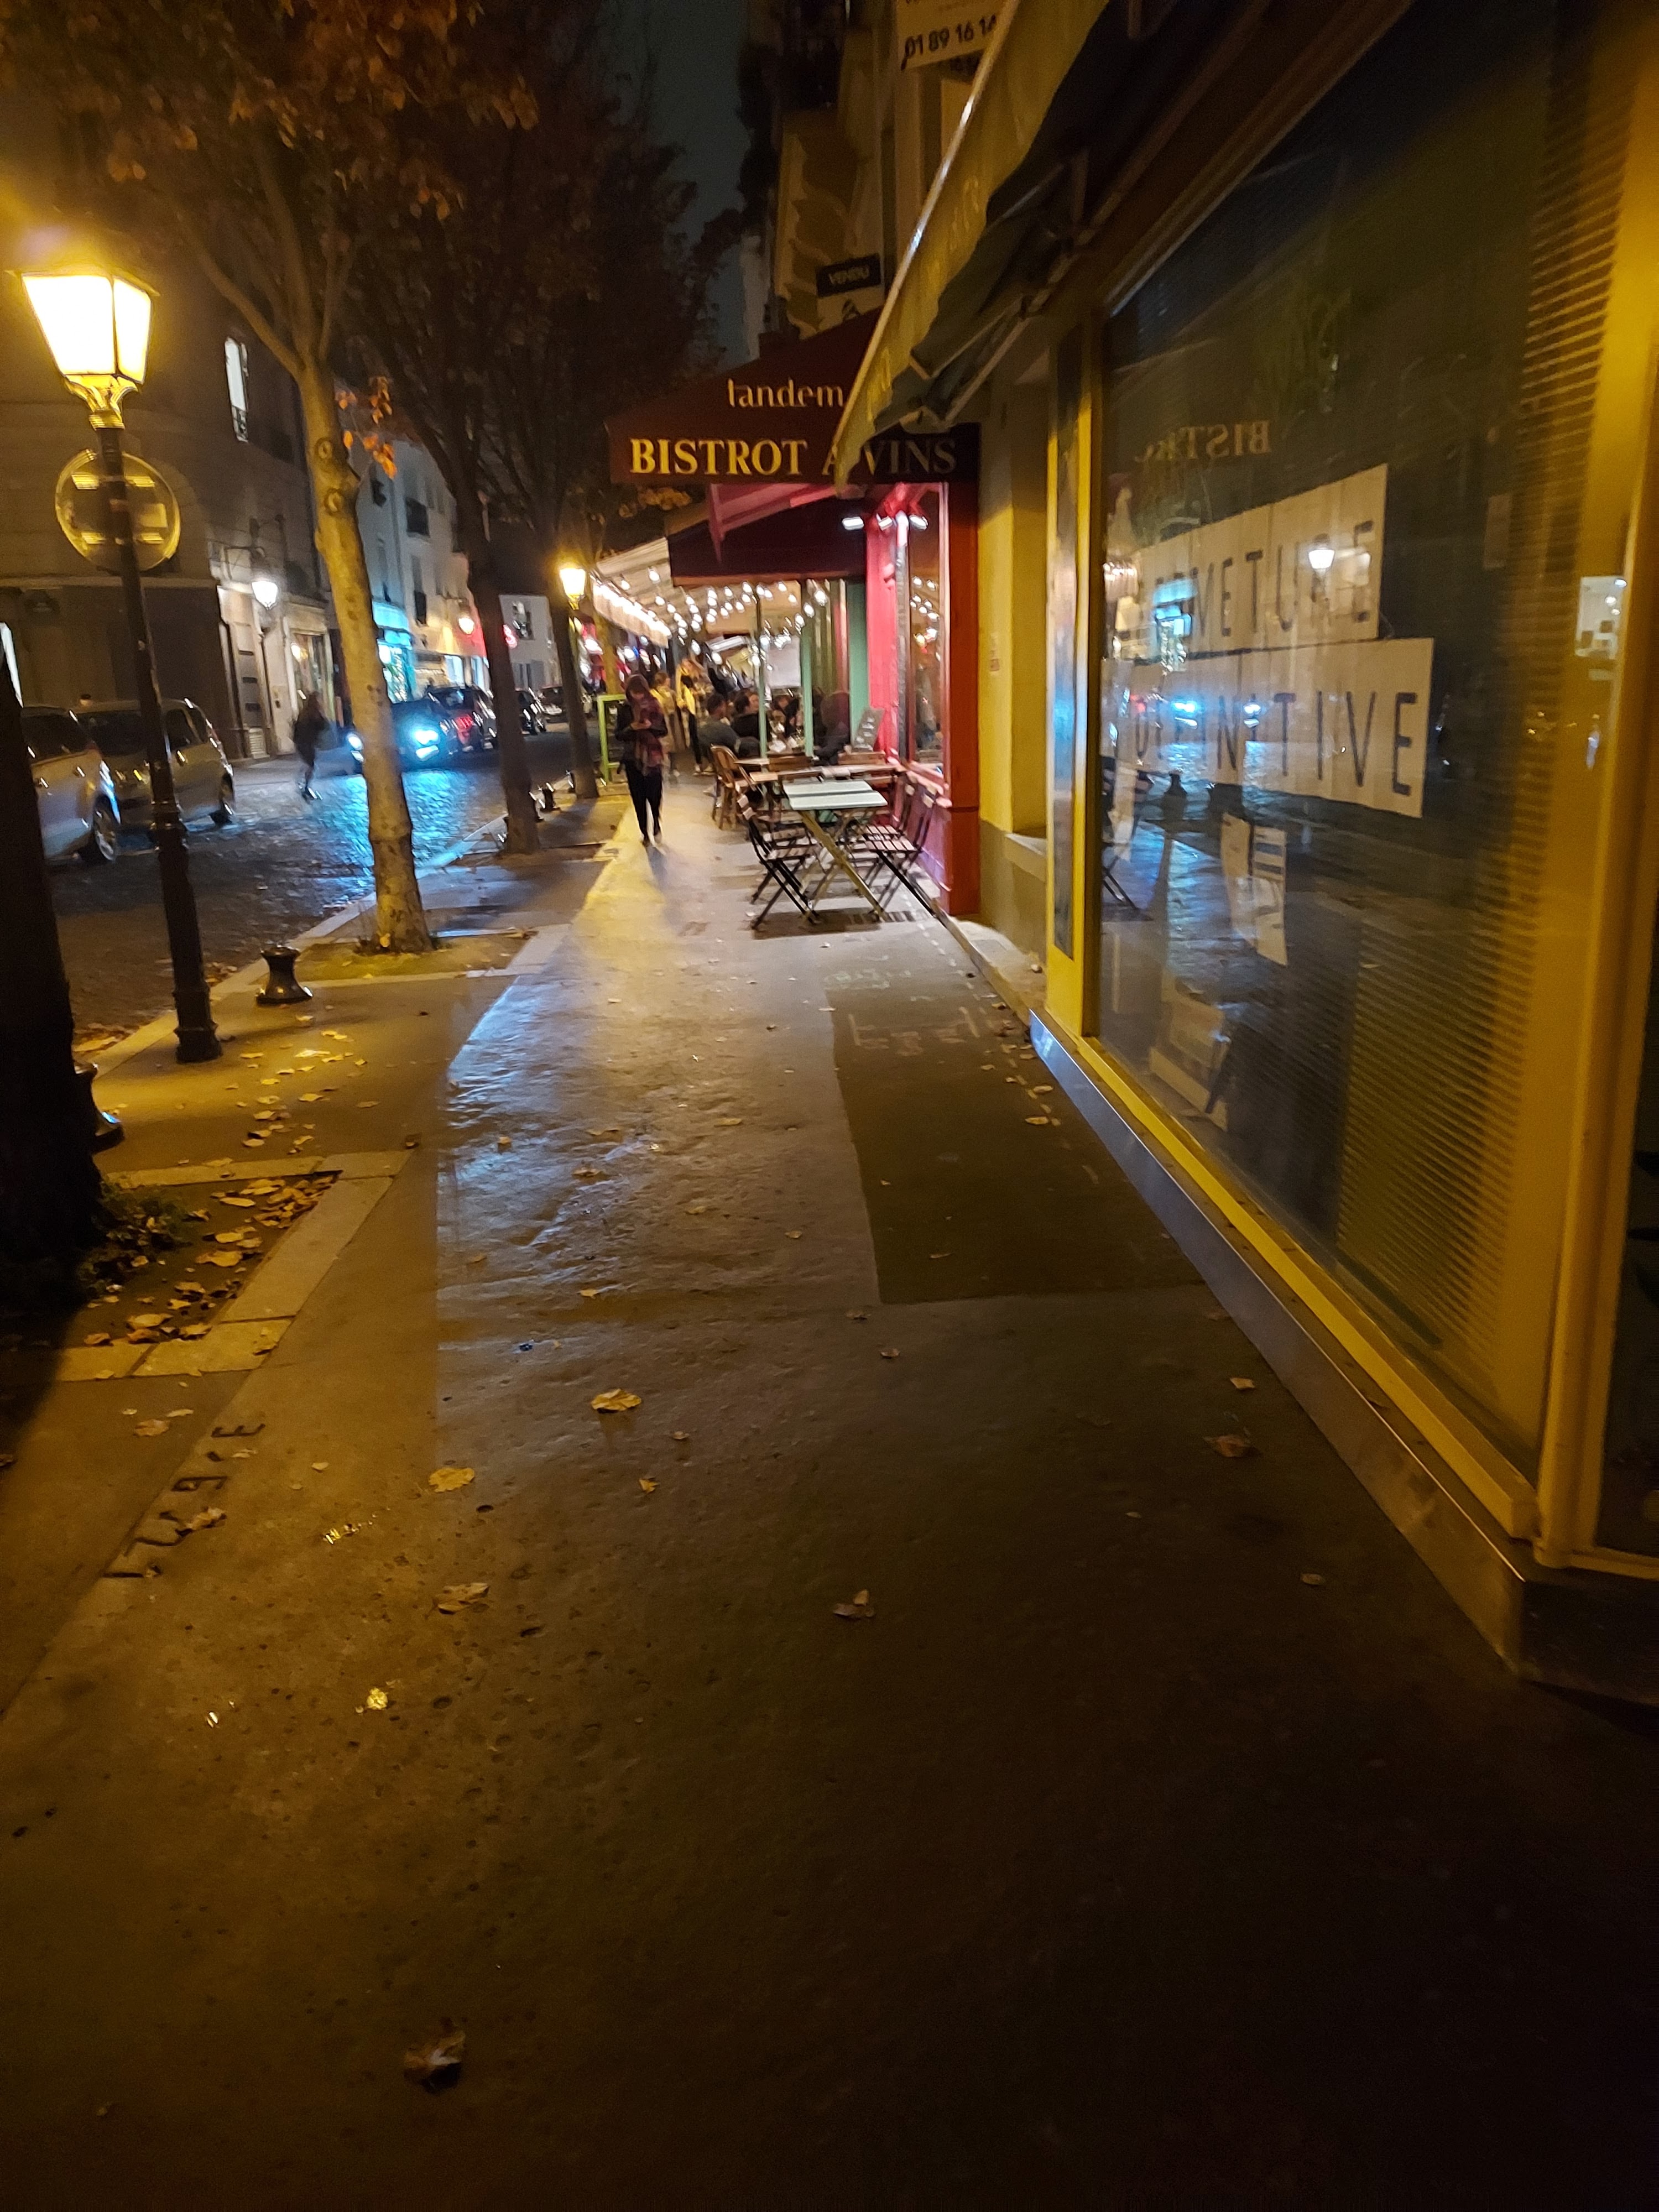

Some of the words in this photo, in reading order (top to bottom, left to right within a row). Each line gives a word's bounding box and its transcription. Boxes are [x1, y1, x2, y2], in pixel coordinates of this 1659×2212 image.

[904, 34, 924, 58] 01
[956, 21, 974, 43] 16
[728, 378, 843, 408] tandem
[629, 439, 808, 476] BISTROT
[863, 438, 958, 476] VINS
